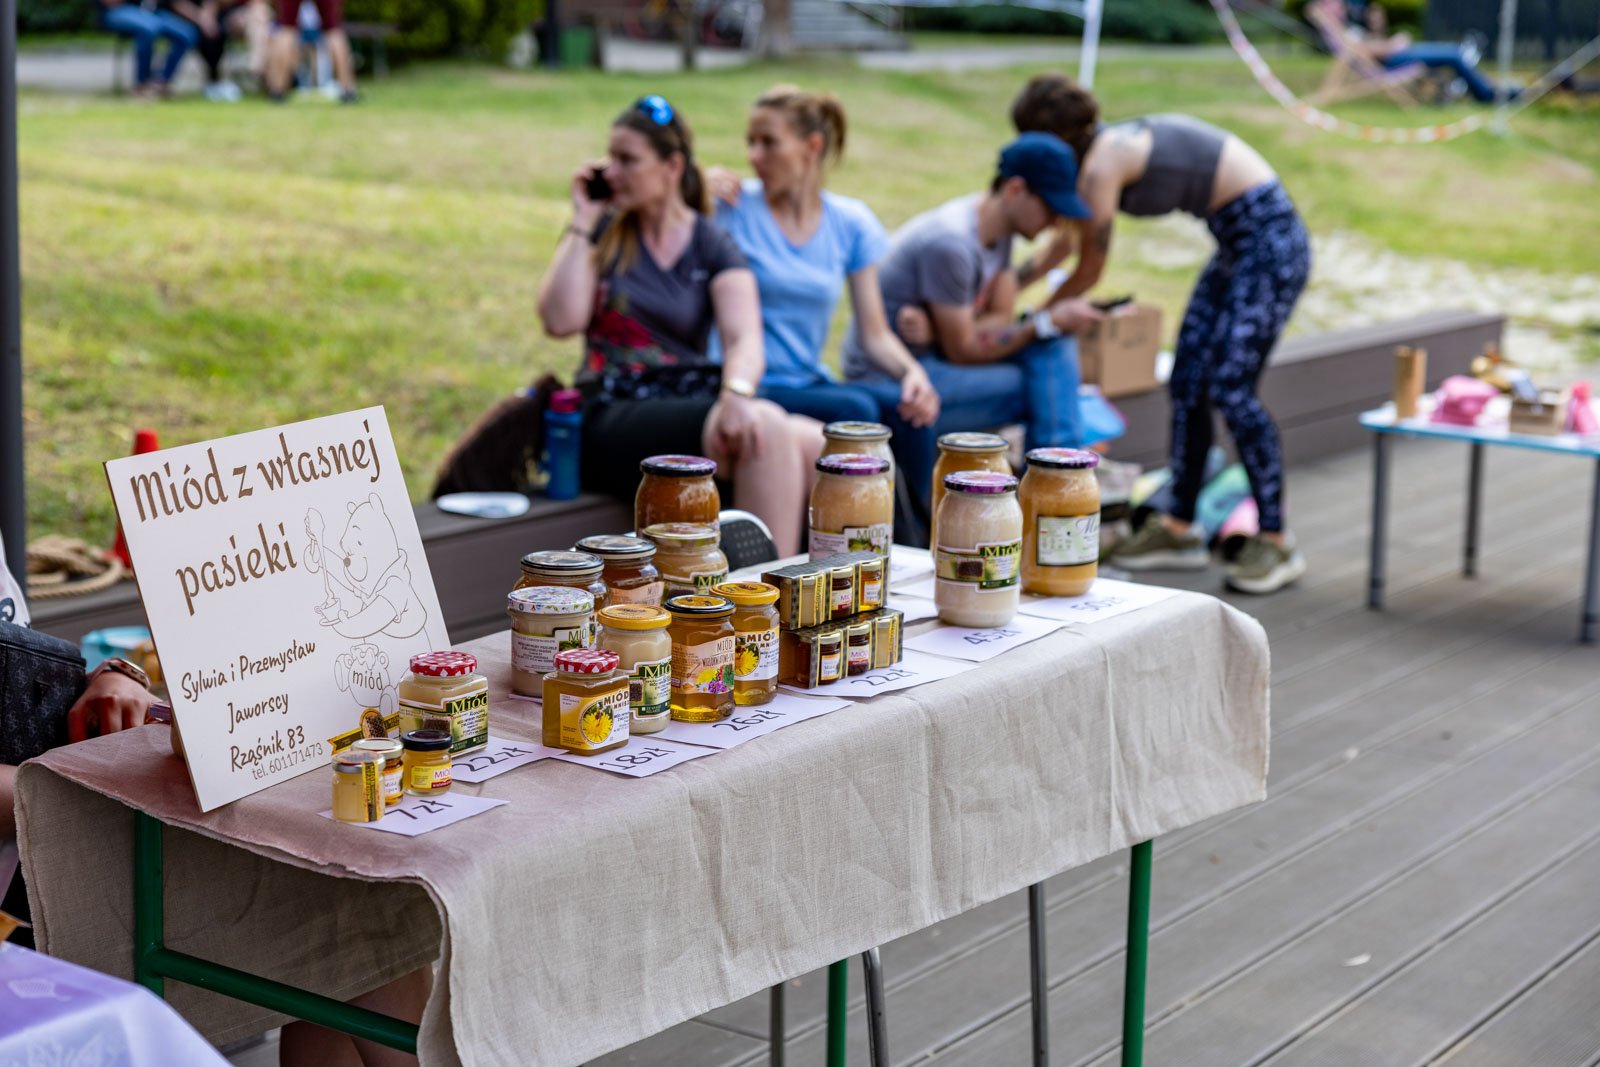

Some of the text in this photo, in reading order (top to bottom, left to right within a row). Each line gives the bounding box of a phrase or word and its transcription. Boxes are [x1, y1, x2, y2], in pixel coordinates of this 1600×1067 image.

[129, 418, 381, 523] Miód z własnej
[175, 521, 298, 617] pasieki
[716, 637, 733, 653] MIÓD
[181, 639, 316, 702] Sylwia i Przemysław
[352, 669, 383, 692] miód
[850, 667, 919, 687] 22zł
[603, 690, 629, 706] MIÓD
[226, 692, 289, 735] Jaworscy
[711, 708, 787, 732] 26zł
[230, 724, 305, 773] Rząśnik 83
[252, 742, 325, 781] tel. 601171473
[451, 747, 534, 773] 22zł
[599, 747, 677, 771] 18zł
